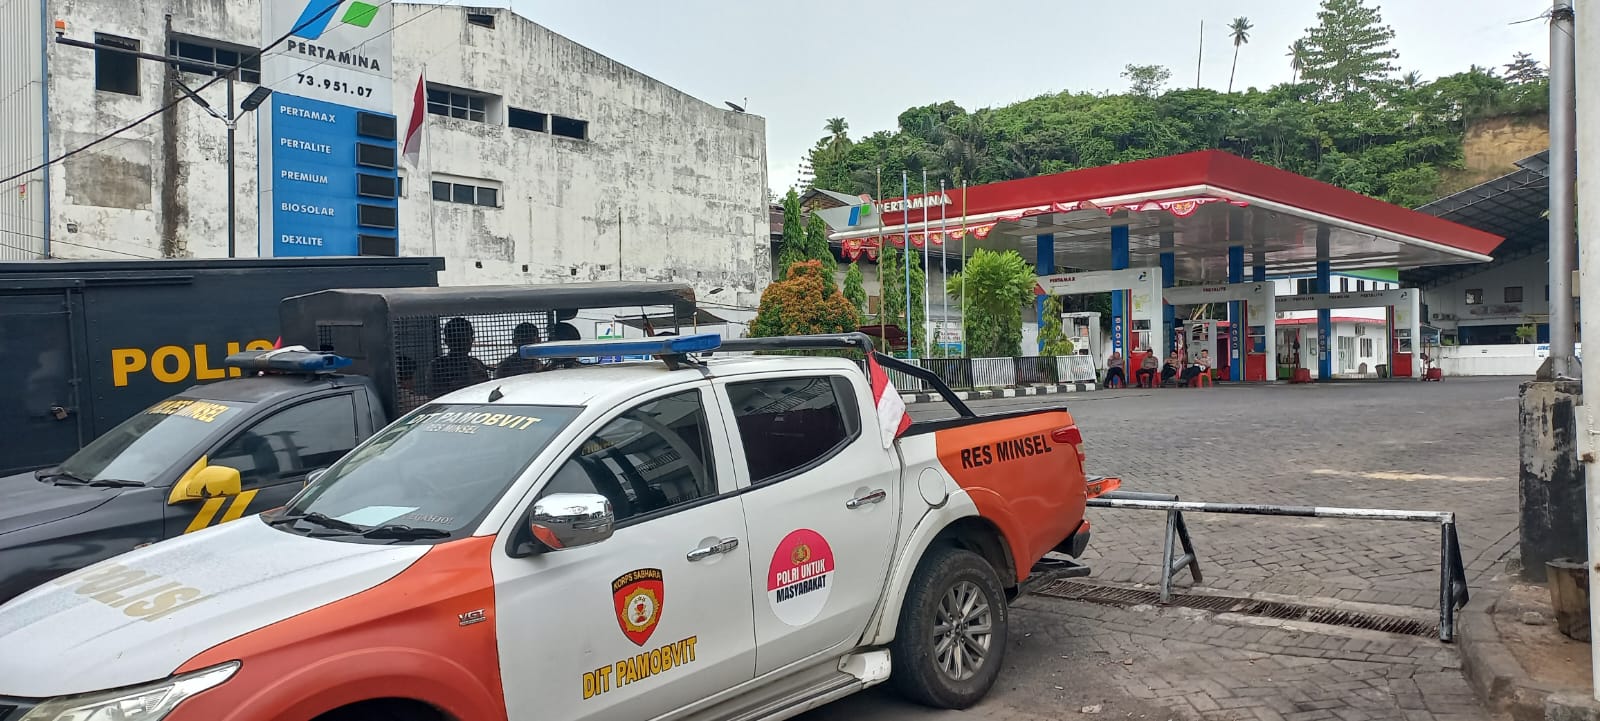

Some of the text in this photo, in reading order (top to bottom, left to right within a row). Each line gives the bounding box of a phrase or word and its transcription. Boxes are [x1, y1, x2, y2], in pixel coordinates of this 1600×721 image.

[288, 40, 380, 71] PERTAMINA
[297, 73, 373, 98] 73.951.07
[280, 106, 336, 122] PERTAMAX
[280, 137, 332, 154] PERTALITE
[281, 170, 328, 184] PREMIUM
[281, 234, 323, 248] DEXLITE
[111, 338, 276, 387] POLI
[439, 411, 542, 430] PAMOBVIT
[960, 434, 1053, 470] RES MINSEL
[613, 569, 662, 591] KORPS SABHARA
[776, 558, 826, 587] POLRI UNTUK
[53, 564, 212, 622] POLISI
[776, 574, 827, 604] MASYARAKAT
[582, 635, 698, 701] DIT PAMOBVIT
